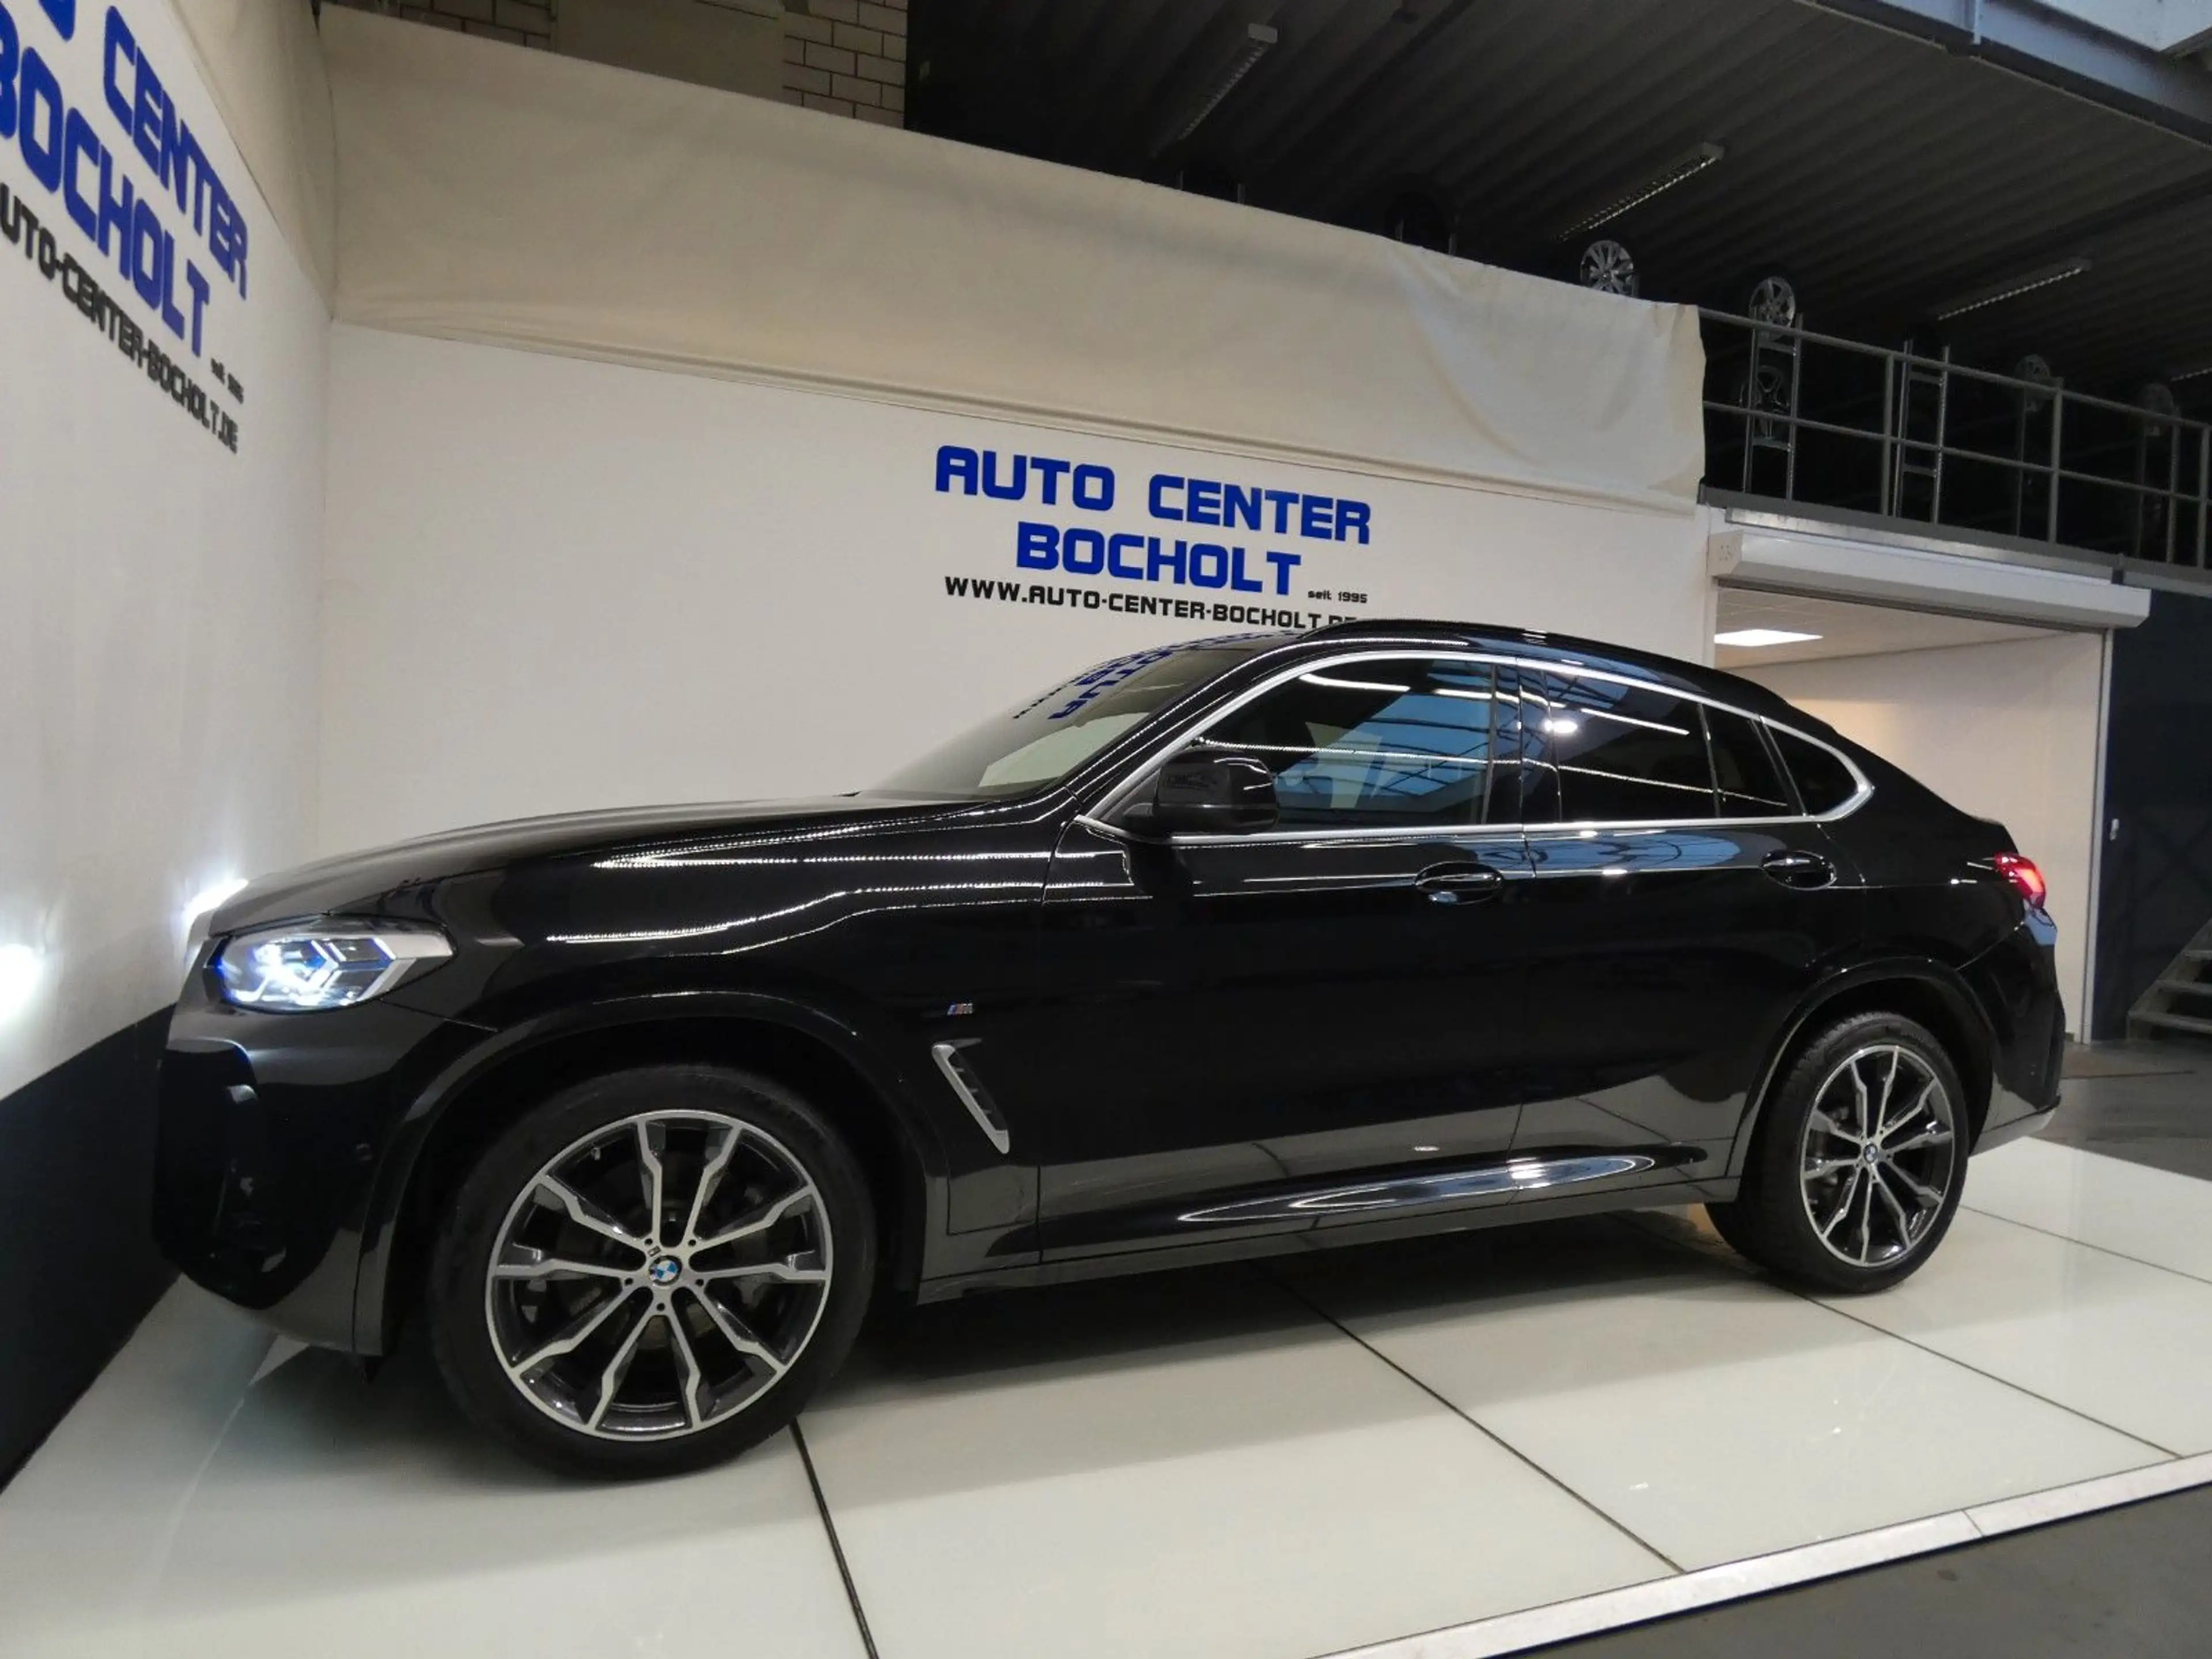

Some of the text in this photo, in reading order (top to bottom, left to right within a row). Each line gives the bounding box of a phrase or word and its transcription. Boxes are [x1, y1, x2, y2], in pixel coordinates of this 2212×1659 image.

[104, 5, 248, 300] CENTER
[935, 445, 1371, 545] AUTO CENTER
[1016, 521, 1302, 596] BOCHOLT
[1308, 590, 1368, 604] seit 1995
